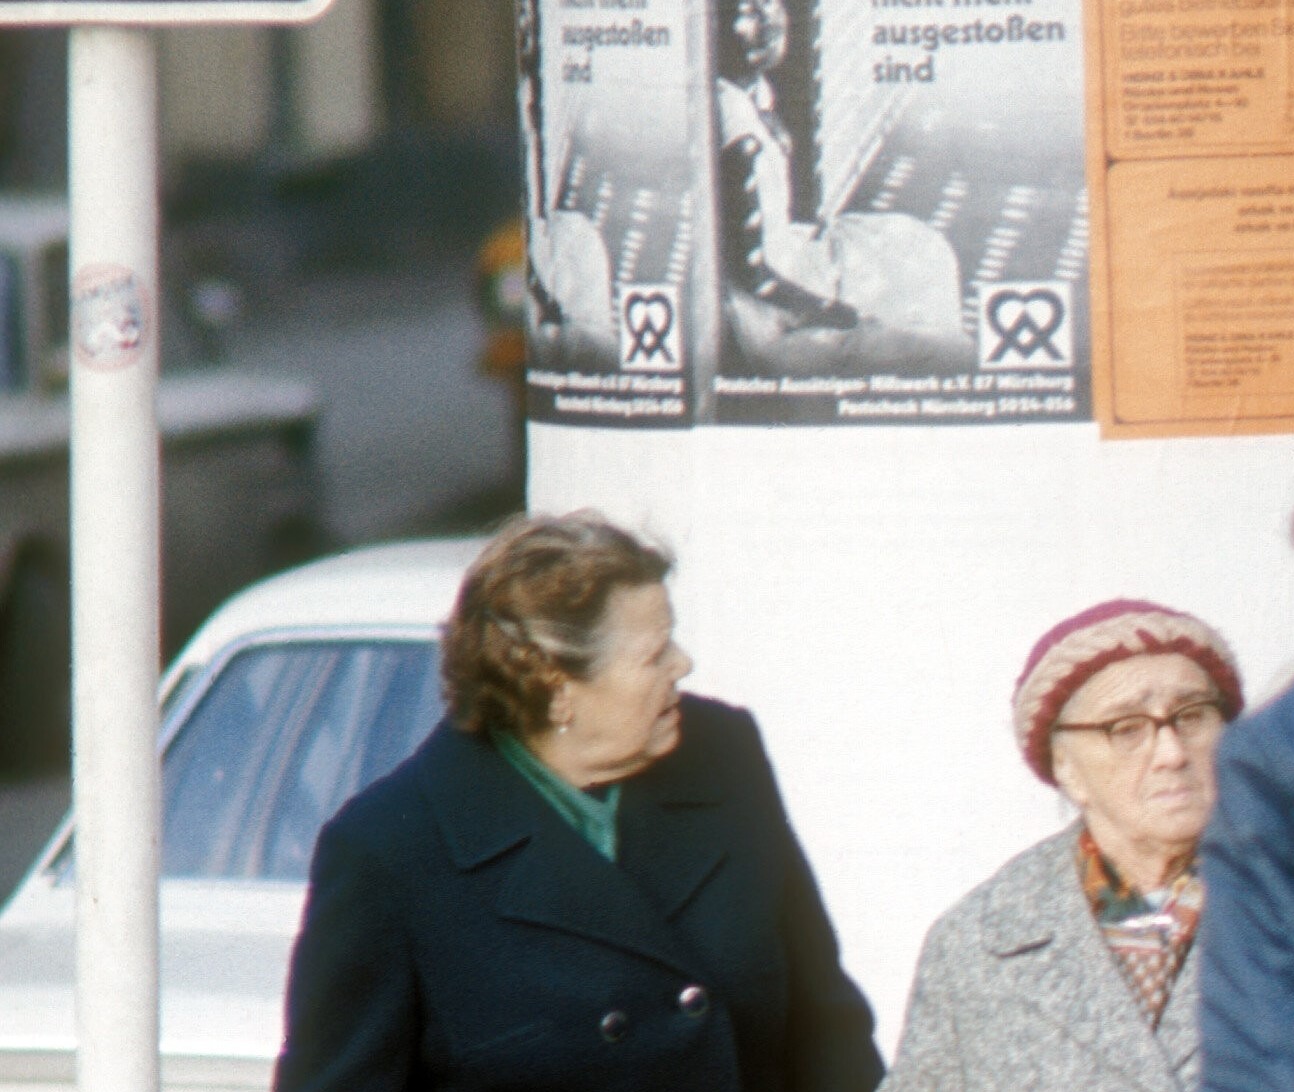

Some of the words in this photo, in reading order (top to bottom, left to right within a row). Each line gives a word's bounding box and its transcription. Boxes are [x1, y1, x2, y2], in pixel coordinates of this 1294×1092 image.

[562, 19, 670, 51] ausgestoßen
[872, 14, 1065, 50] ausgestoßen
[873, 55, 935, 82] sind
